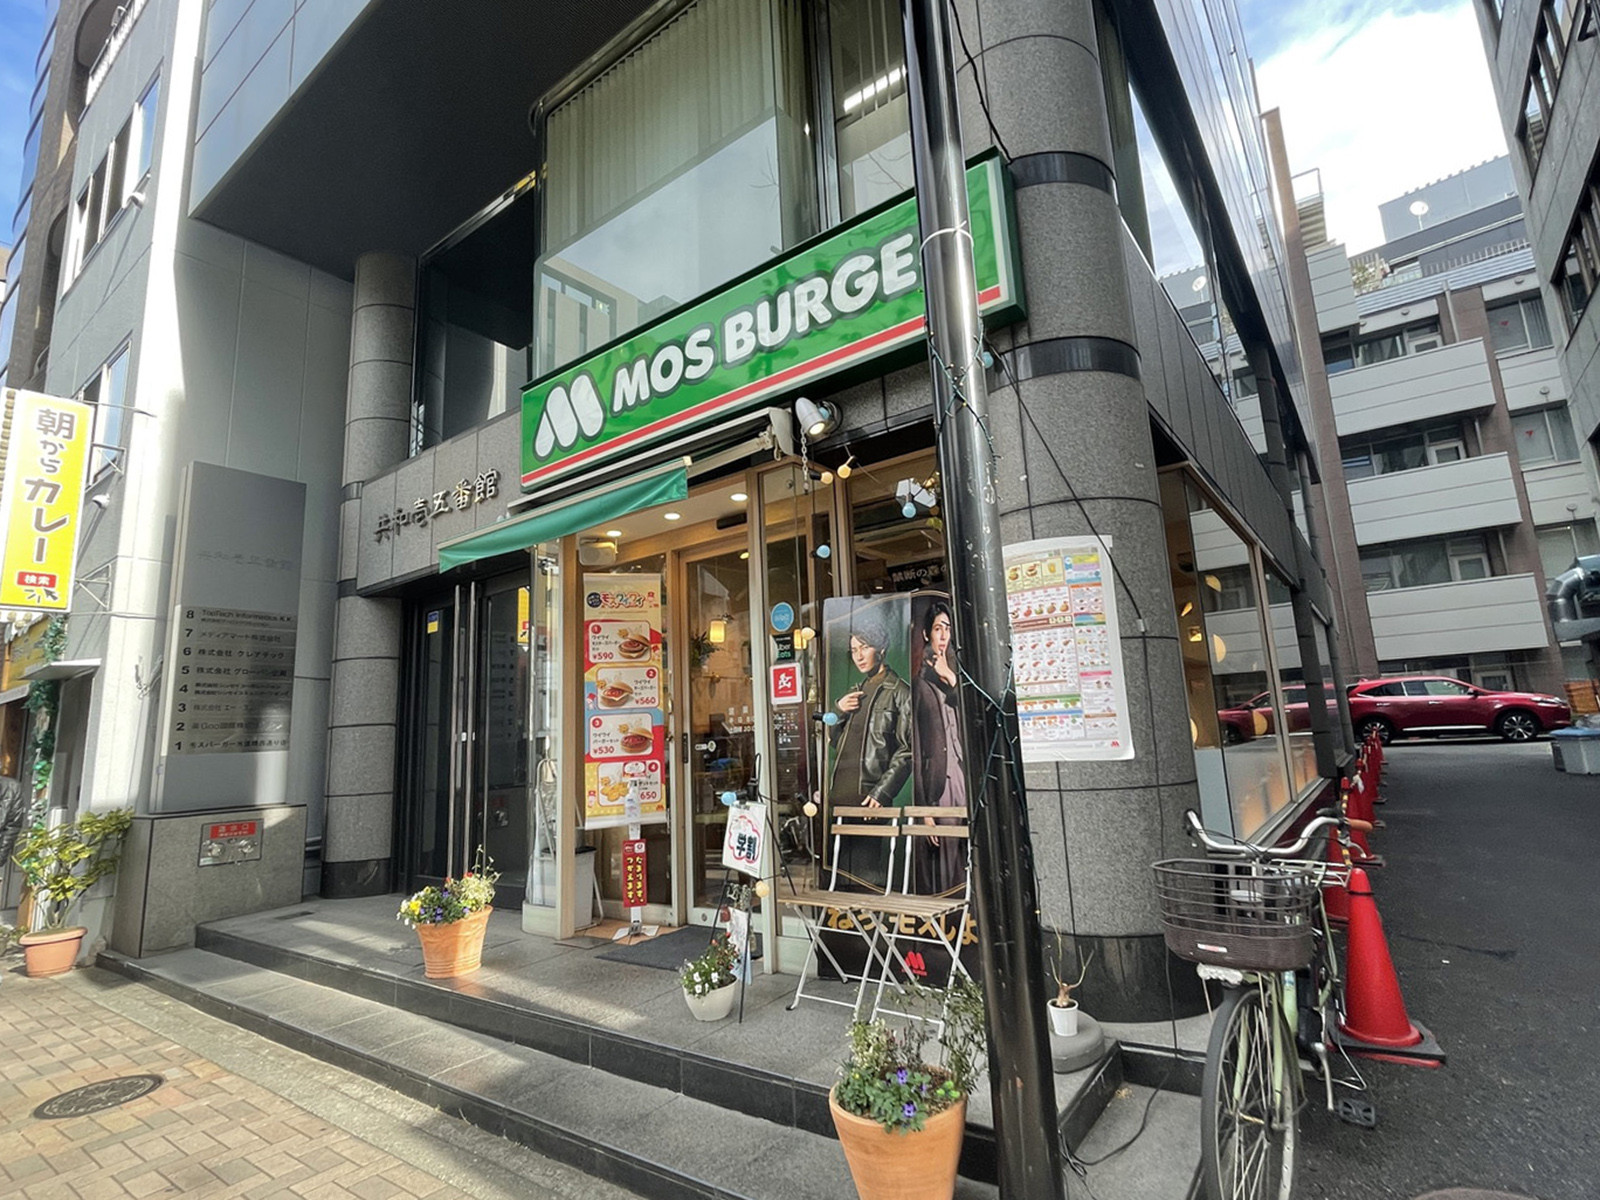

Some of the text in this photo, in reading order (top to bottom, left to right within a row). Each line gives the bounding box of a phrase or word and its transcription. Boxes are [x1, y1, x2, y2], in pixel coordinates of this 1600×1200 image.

[611, 232, 917, 414] MOS BURGE
[24, 408, 76, 562] 朝からカレー
[24, 573, 50, 586] 検索
[186, 610, 194, 619] 8
[185, 628, 193, 637] 7
[183, 647, 191, 656] 6
[198, 648, 232, 657] 株式会社
[181, 665, 190, 674] 5
[179, 684, 188, 693] 4
[178, 703, 186, 712] 3
[176, 722, 185, 731] 2
[175, 741, 182, 750] 1
[593, 746, 614, 754] ¥530
